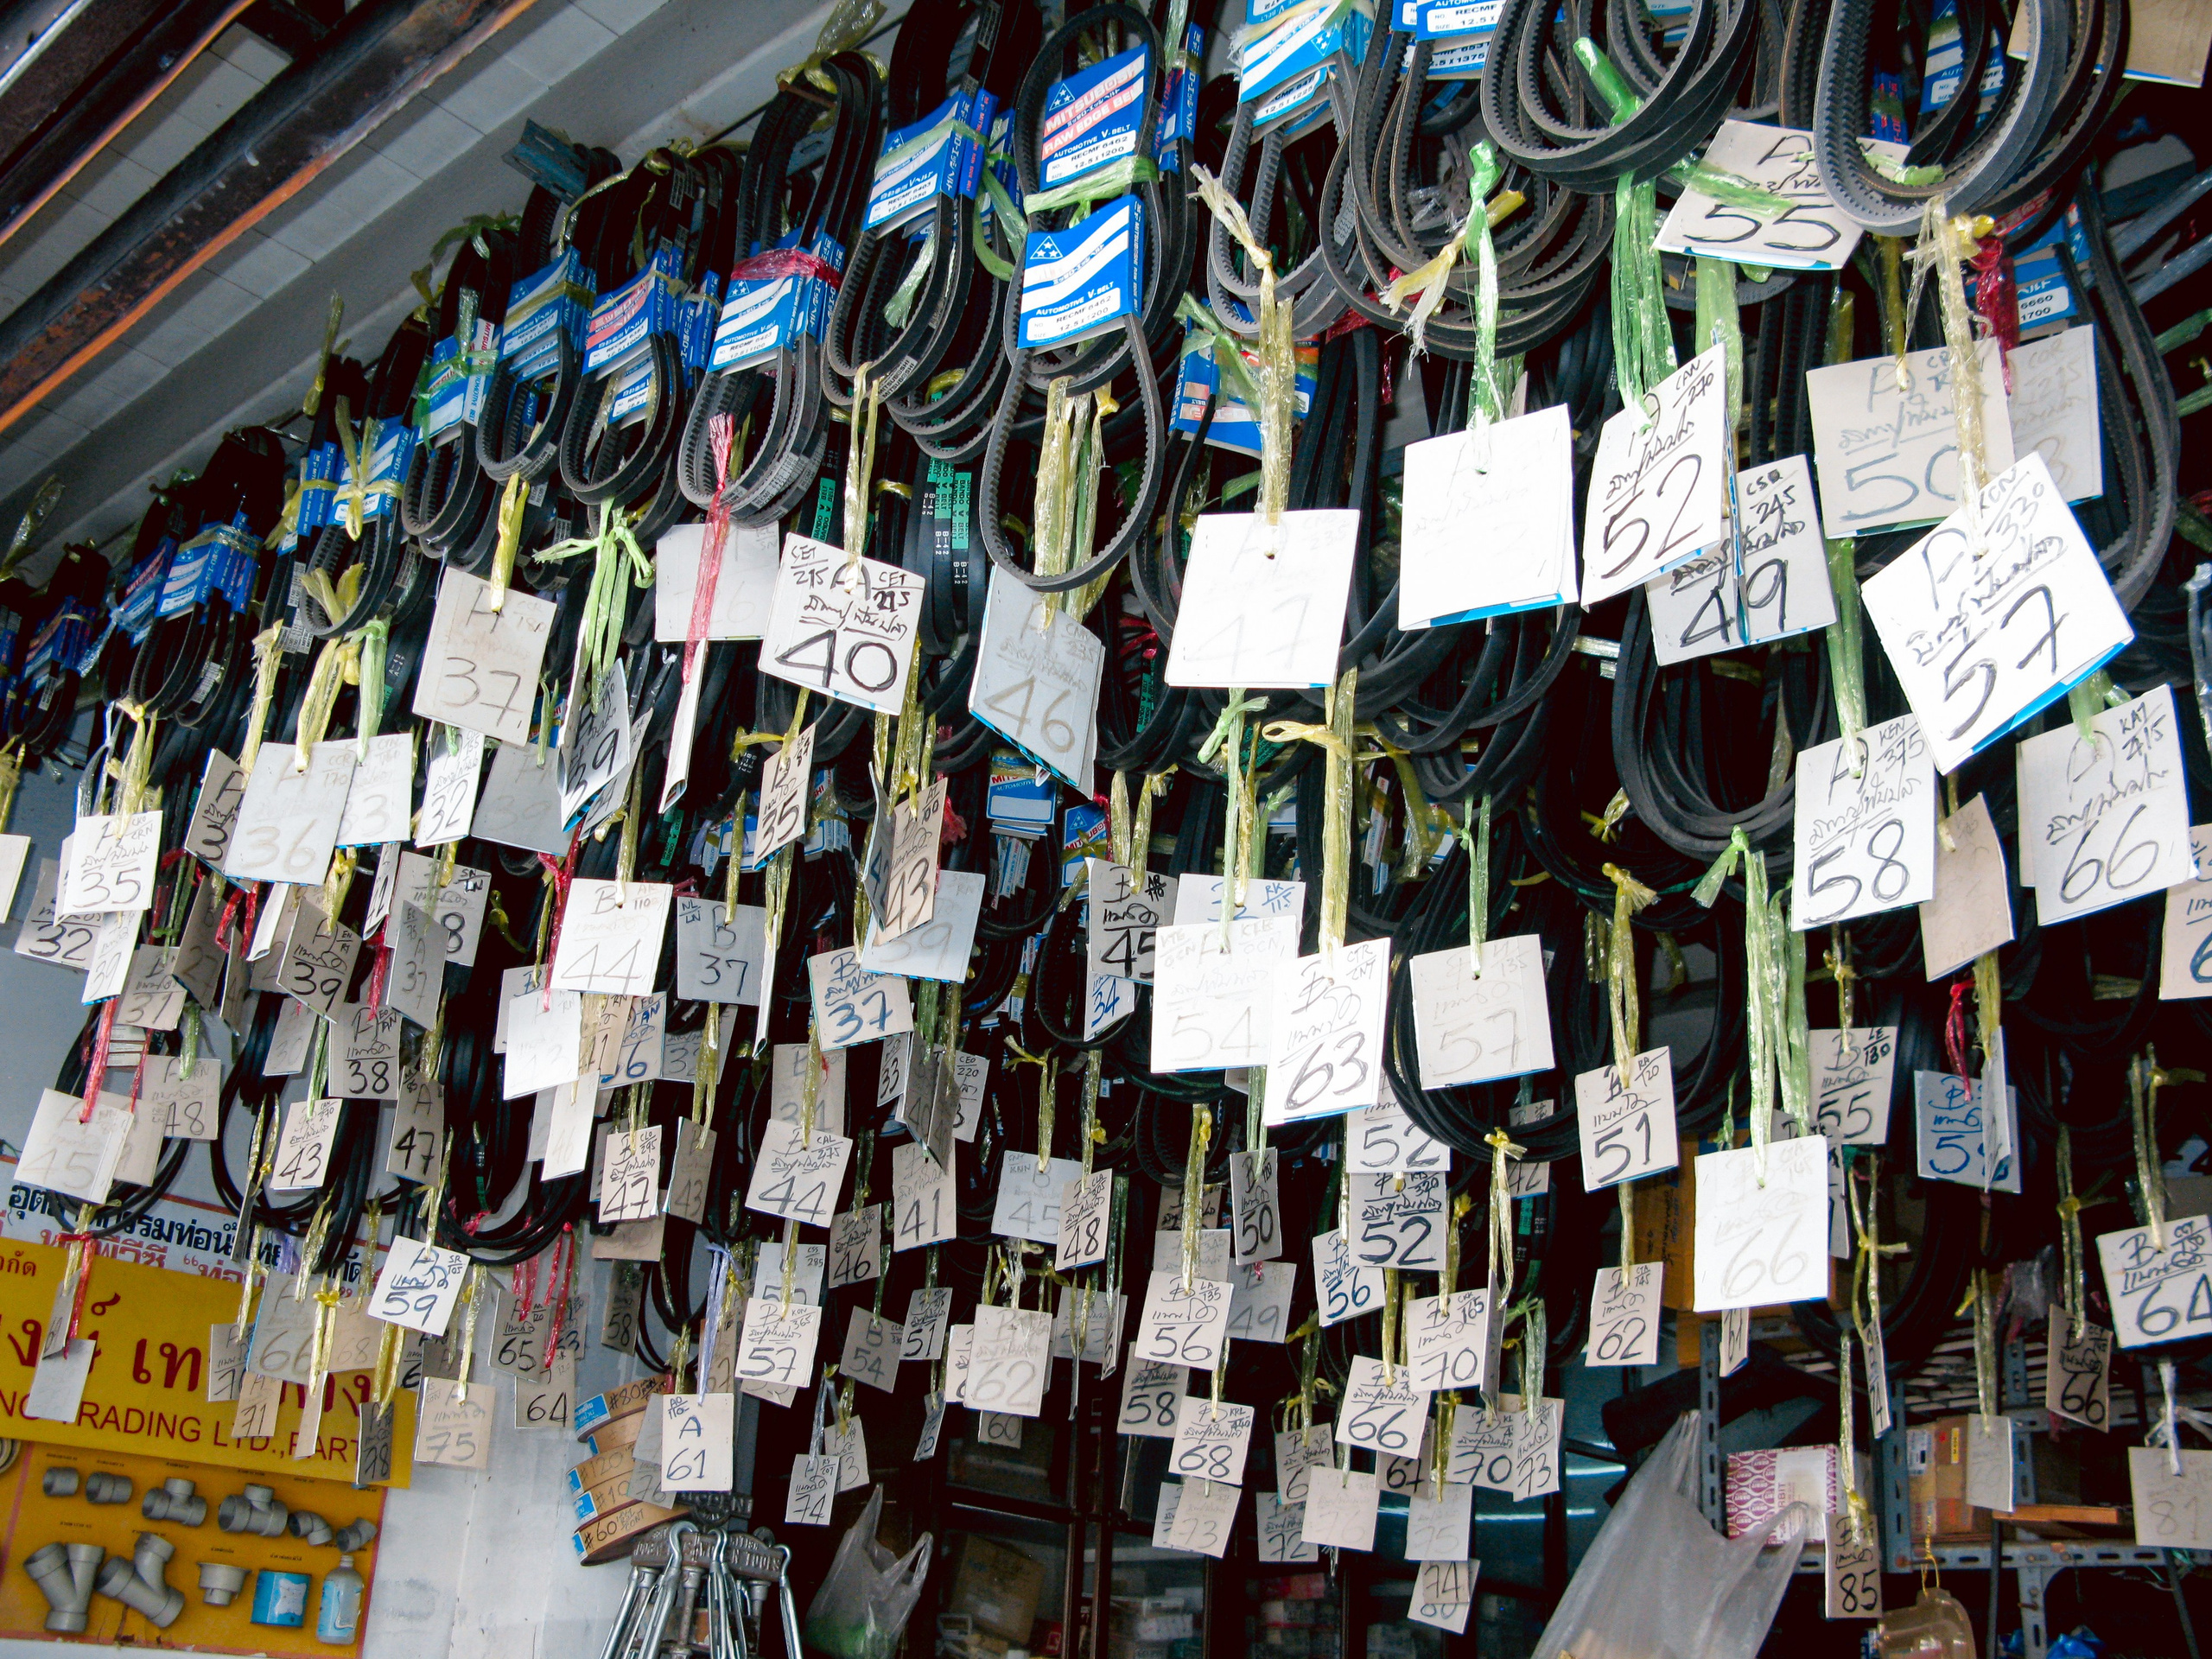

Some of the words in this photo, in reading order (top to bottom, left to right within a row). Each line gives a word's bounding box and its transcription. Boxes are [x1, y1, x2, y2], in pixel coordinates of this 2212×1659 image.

[1044, 130, 1074, 156] RAW
[1053, 136, 1097, 159] AUTOMOTIVE
[1101, 124, 1130, 138] V-BELT
[1683, 203, 1841, 251] 55
[1036, 296, 1084, 315] AUTOMOTIVE
[1088, 281, 1114, 298] V-BELT
[723, 330, 759, 344] AUTOMOTIVE
[814, 516, 823, 538] BANDO
[1602, 454, 1702, 578] 52
[1680, 558, 1789, 646] 49
[775, 629, 896, 693] 40
[1943, 584, 2069, 741] 57
[442, 657, 523, 727] 37
[983, 677, 1075, 753] 46
[247, 816, 318, 873] 36
[758, 789, 800, 858] 35
[1804, 819, 1910, 925] 58
[2059, 804, 2160, 904] 66
[73, 868, 143, 908] 35
[887, 857, 930, 934] 43
[29, 924, 93, 962] 32
[290, 962, 341, 1012] 39
[560, 938, 643, 994] 44
[700, 952, 748, 996] 37
[828, 990, 894, 1043] 37
[1091, 978, 1121, 1028] 34
[1172, 1006, 1266, 1062] 54
[347, 1059, 391, 1095] 38
[957, 1067, 979, 1077] 220
[1285, 1031, 1369, 1110] 63
[1816, 1090, 1872, 1140] 55
[279, 1142, 322, 1186] 43
[395, 1125, 435, 1176] 47
[1360, 1123, 1441, 1168] 52
[1595, 1112, 1651, 1184] 51
[602, 1176, 650, 1218] 47
[674, 1179, 703, 1217] 43
[759, 1176, 827, 1222] 44
[899, 1187, 940, 1243] 41
[1064, 1217, 1101, 1264] 48
[1242, 1203, 1274, 1256] 50
[1358, 1215, 1437, 1267] 52
[834, 1242, 871, 1281] 46
[383, 1292, 438, 1328] 59
[1325, 1267, 1370, 1319] 56
[607, 1313, 633, 1346] 58
[903, 1322, 937, 1357] 51
[1149, 1324, 1213, 1362] 56
[1228, 1305, 1280, 1340] 49
[1597, 1317, 1647, 1361] 62
[498, 1338, 537, 1372] 65
[741, 1346, 798, 1382] 57
[1421, 1348, 1478, 1389] 70
[971, 1359, 1037, 1408] 62
[2060, 1372, 2106, 1425] 66
[526, 1392, 568, 1423] 64
[679, 1414, 703, 1439] A
[1122, 1392, 1176, 1427] 58
[1348, 1406, 1407, 1449] 66
[665, 1449, 707, 1480] 61
[1179, 1445, 1233, 1478] 68
[1453, 1451, 1512, 1484] 70
[1517, 1452, 1551, 1497] 73
[793, 1492, 824, 1525] 74
[584, 1521, 618, 1551] #60
[1840, 1573, 1879, 1613] 85
